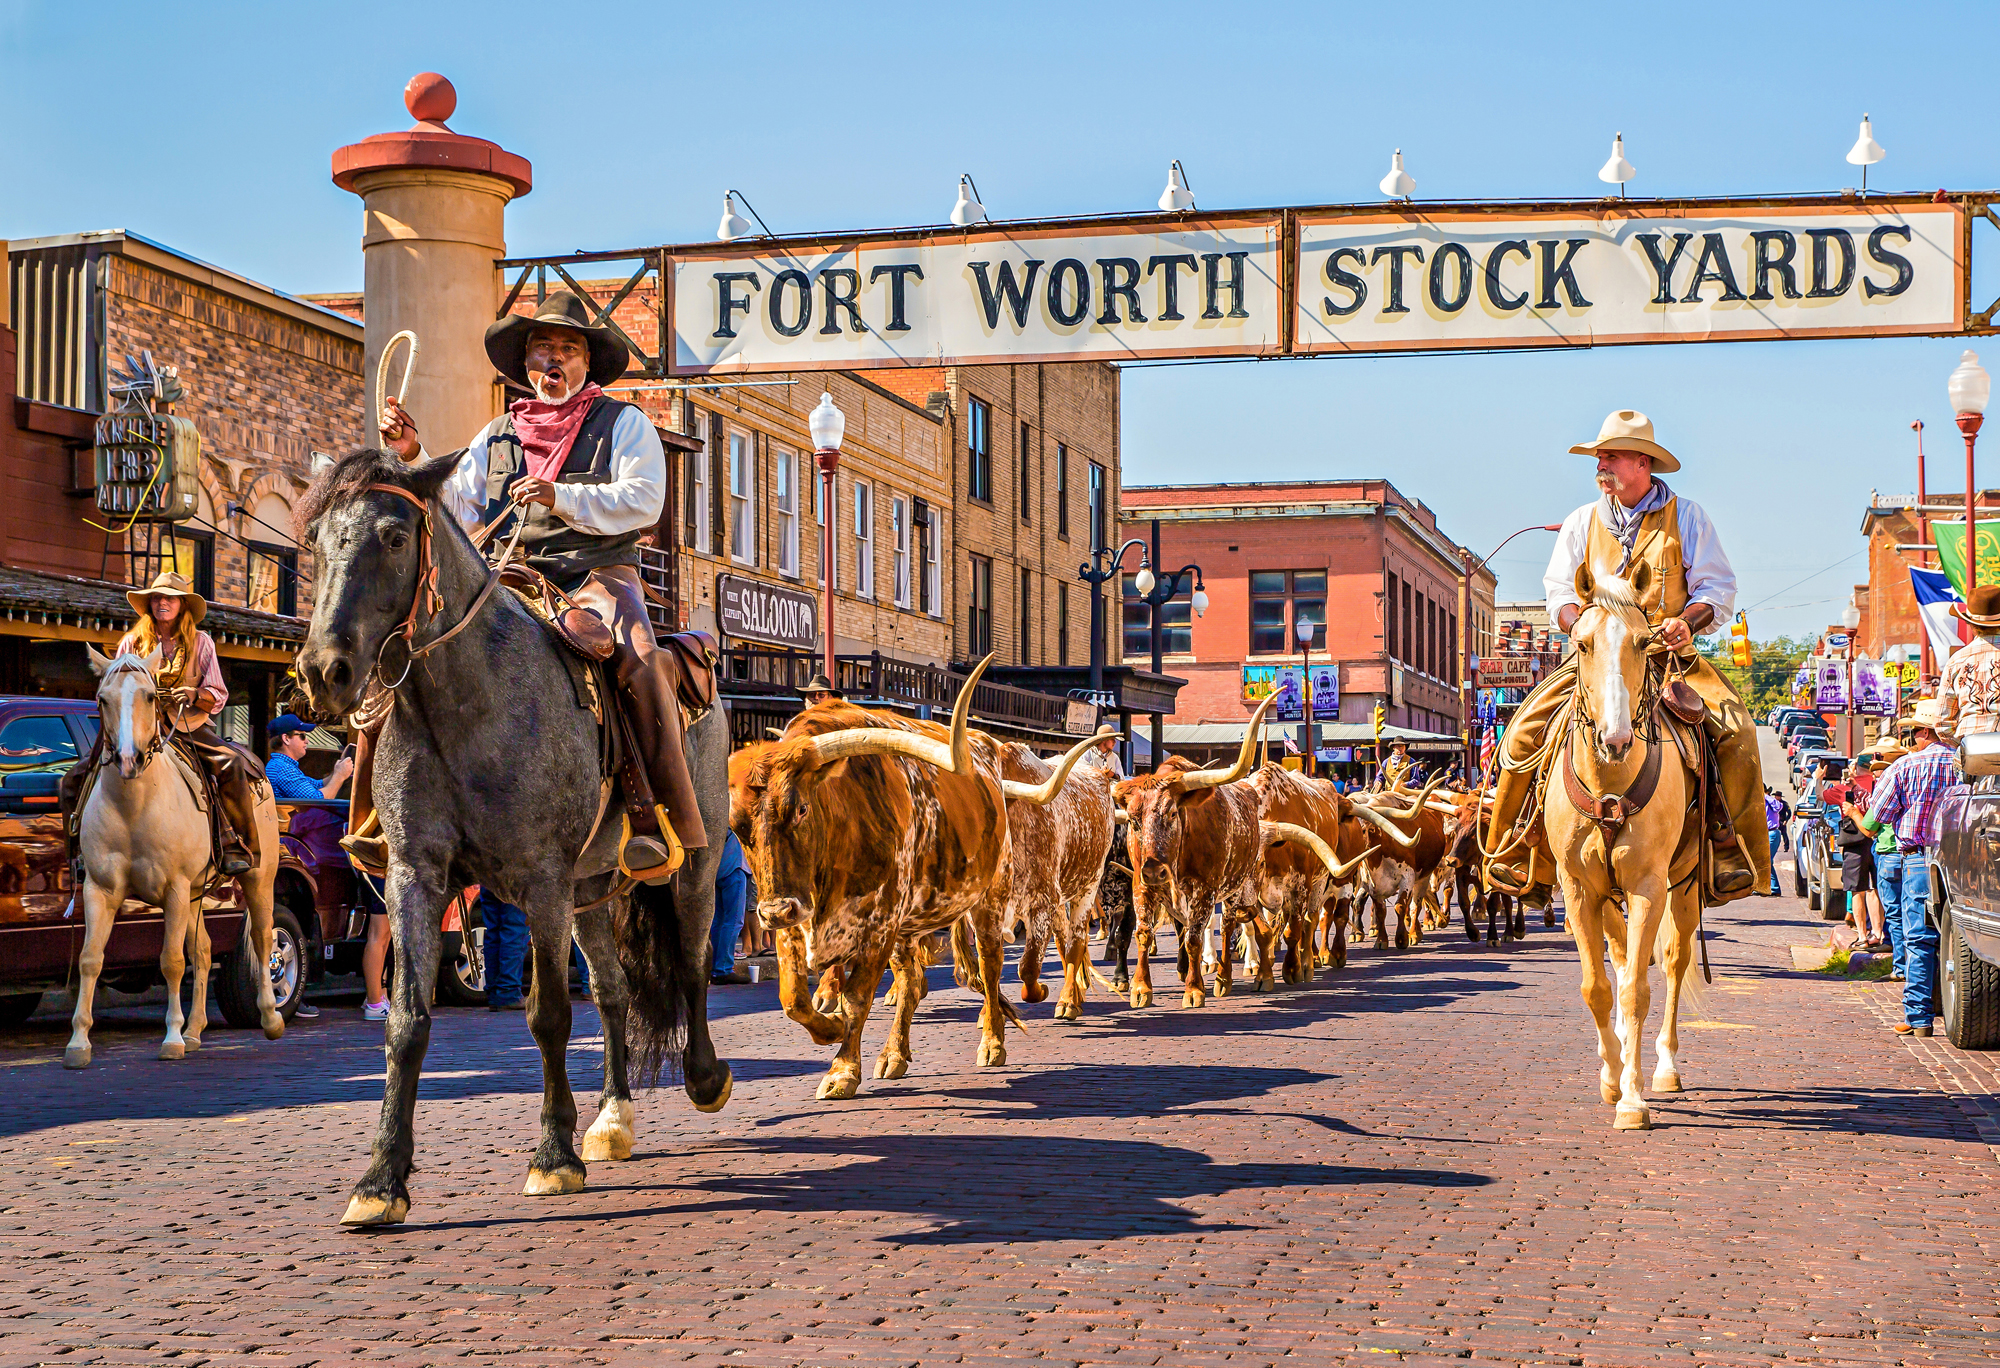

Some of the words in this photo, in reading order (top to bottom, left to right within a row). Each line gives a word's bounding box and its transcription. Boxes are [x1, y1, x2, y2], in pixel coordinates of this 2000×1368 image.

[710, 263, 925, 340] FORT
[966, 250, 1251, 330] WORTH
[1323, 237, 1594, 317] STOCK
[1634, 224, 1915, 305] YARDS
[95, 418, 168, 446] KNIFE
[97, 482, 170, 511] ALLEY
[741, 588, 798, 638] SALOON
[1480, 661, 1503, 674] STAR
[1507, 660, 1531, 673] CAFE
[1316, 691, 1335, 700] AMP
[1821, 684, 1842, 692] AMP
